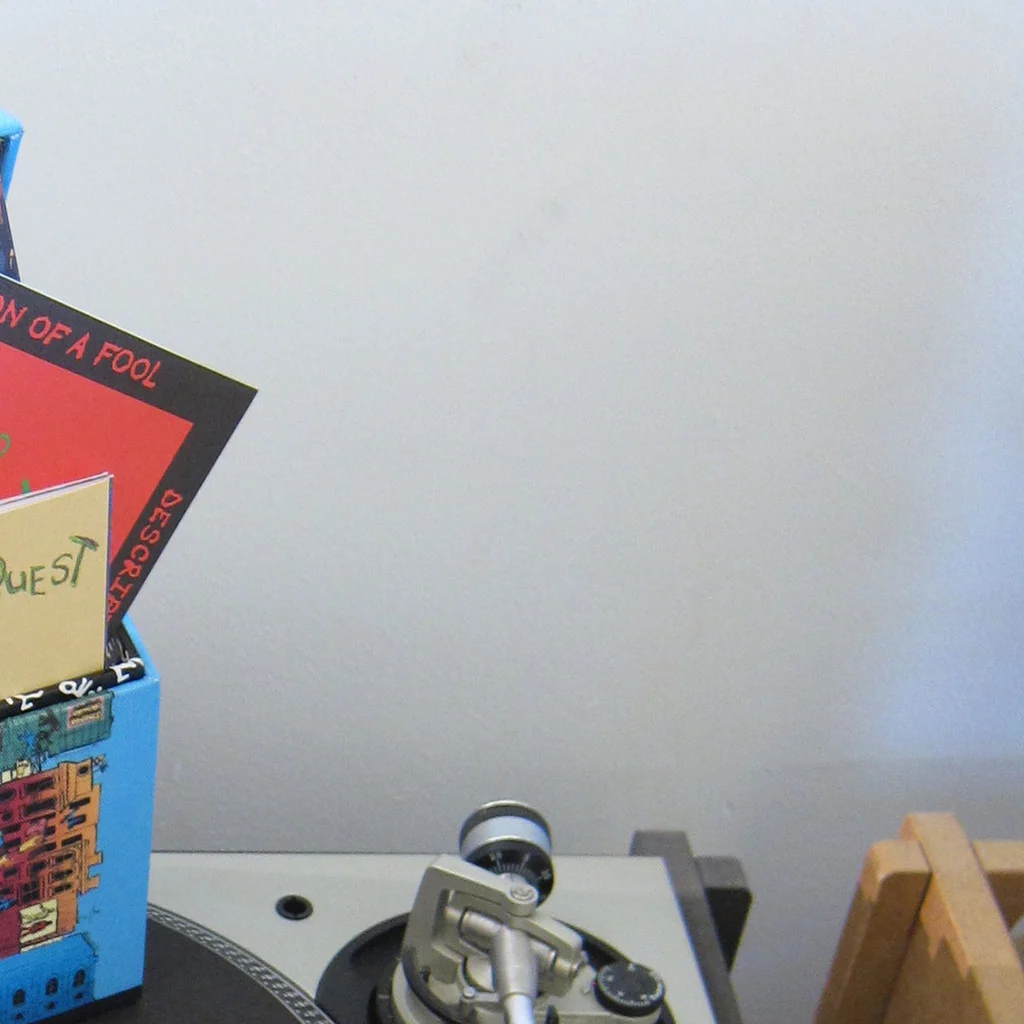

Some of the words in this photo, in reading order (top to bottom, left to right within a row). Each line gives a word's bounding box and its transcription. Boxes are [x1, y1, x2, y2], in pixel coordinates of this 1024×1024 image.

[29, 315, 73, 346] OF
[66, 332, 92, 360] A
[92, 341, 162, 390] FOOL
[106, 488, 184, 623] DESCRIP
